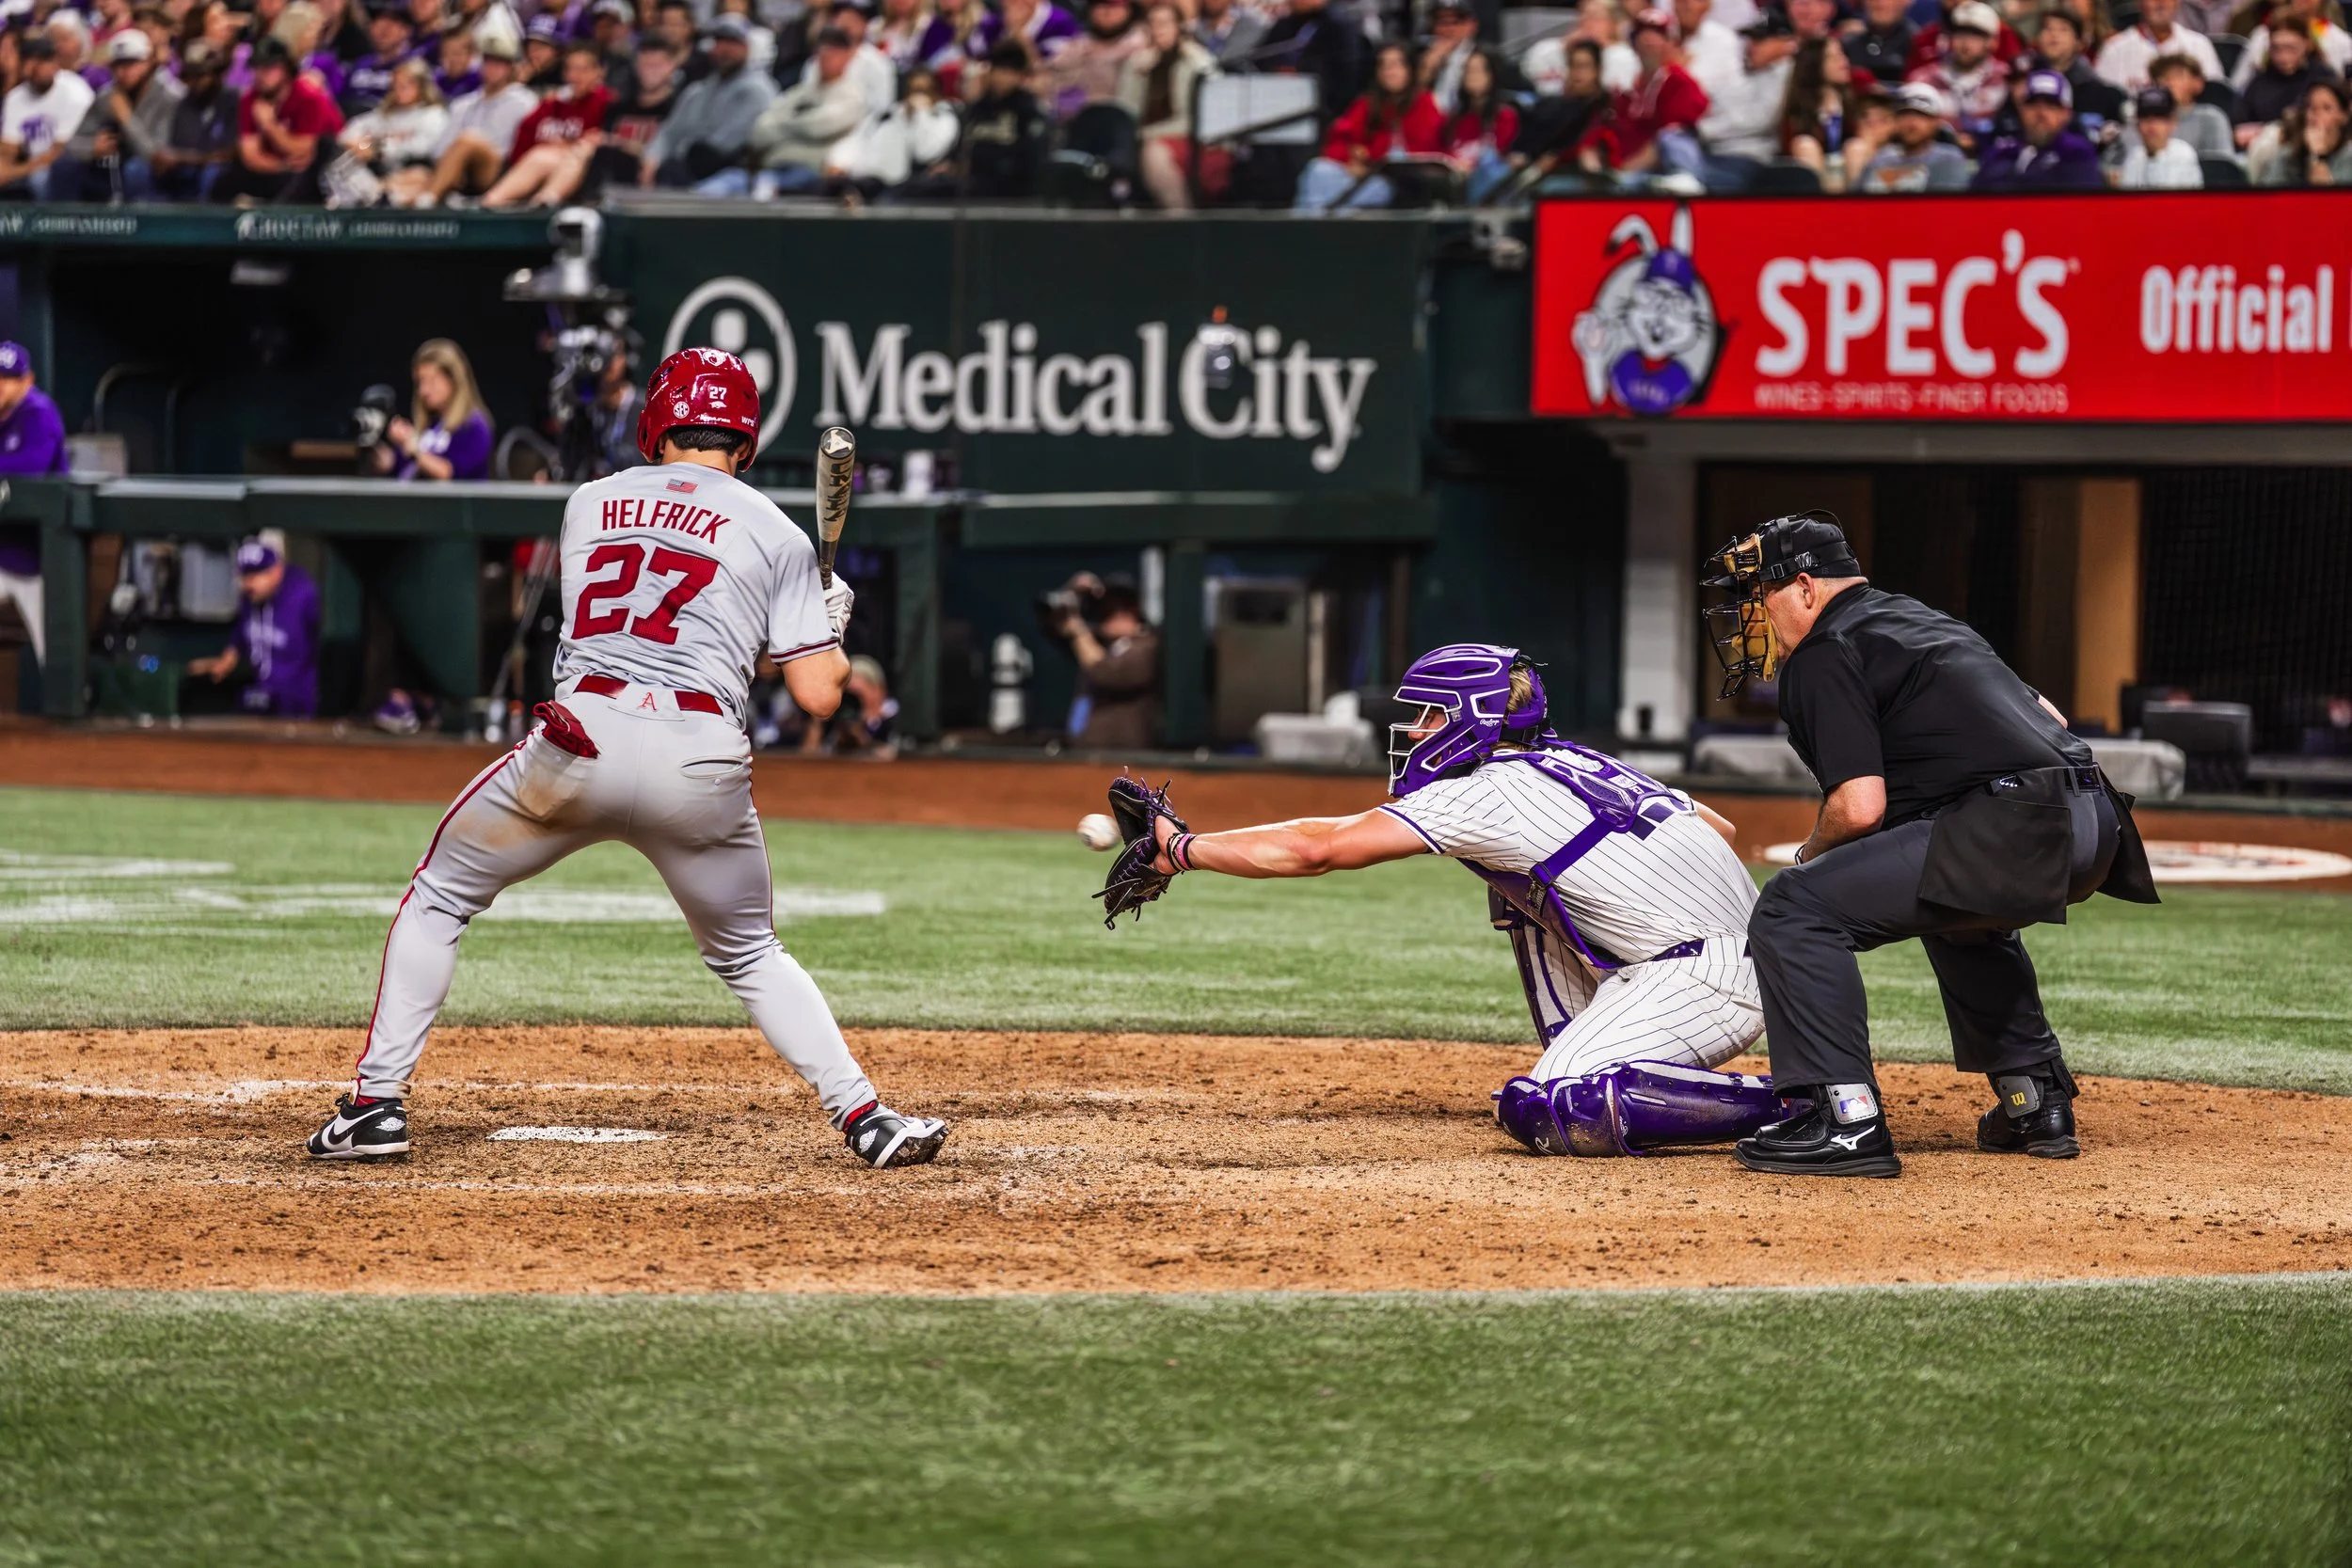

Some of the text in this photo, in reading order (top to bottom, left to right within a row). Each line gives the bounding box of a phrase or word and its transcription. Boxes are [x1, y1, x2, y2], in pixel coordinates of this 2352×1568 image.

[1755, 229, 2070, 377] SPEC'S
[2140, 263, 2335, 355] Official
[708, 386, 727, 400] 27
[815, 322, 1376, 472] Medical City
[601, 499, 732, 545] HELFRICK
[570, 543, 720, 646] 27
